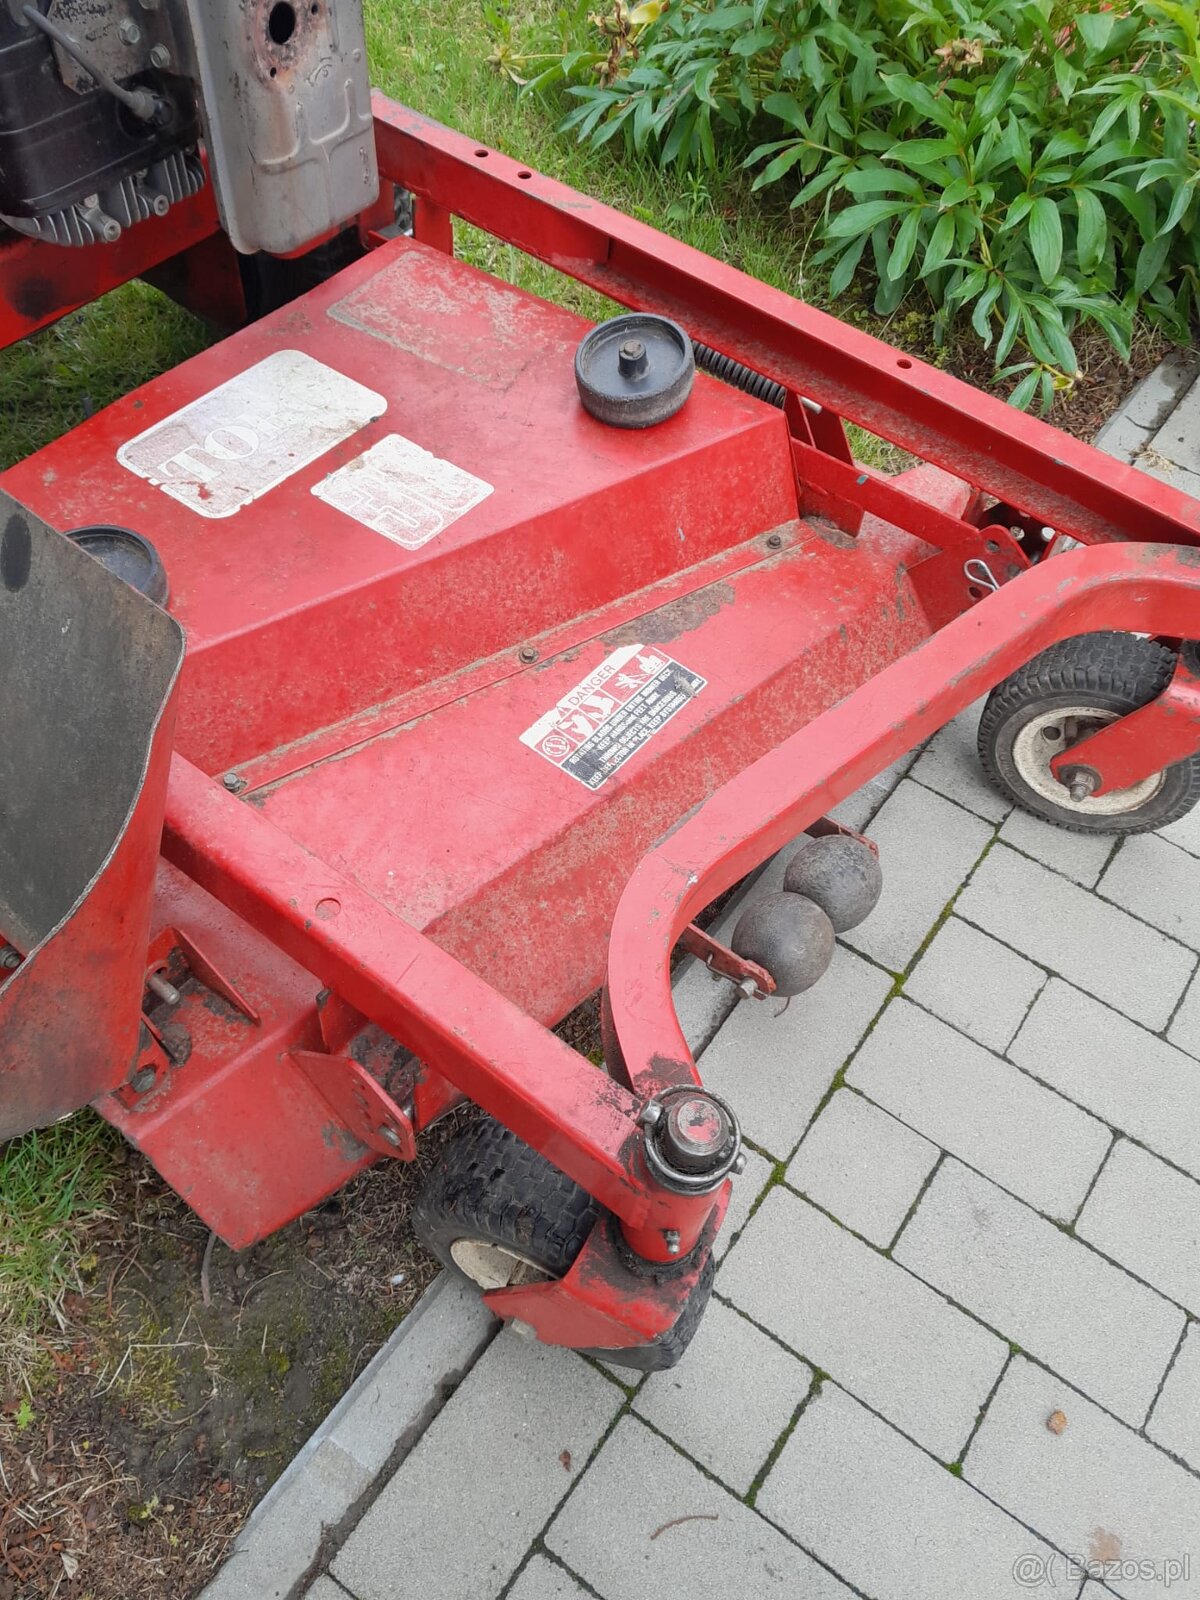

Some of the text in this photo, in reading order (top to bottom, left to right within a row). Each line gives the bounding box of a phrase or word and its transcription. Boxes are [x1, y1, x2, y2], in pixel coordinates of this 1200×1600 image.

[568, 665, 616, 705] DANGER
[569, 741, 595, 764] ROTATING
[609, 709, 628, 726] UNDER
[587, 771, 604, 785] KEEP
[646, 715, 663, 728] KEEP
[596, 735, 613, 750] KEEP
[632, 702, 648, 715] FEET
[618, 722, 642, 744] OBJECTS
[638, 714, 651, 724] ARE
